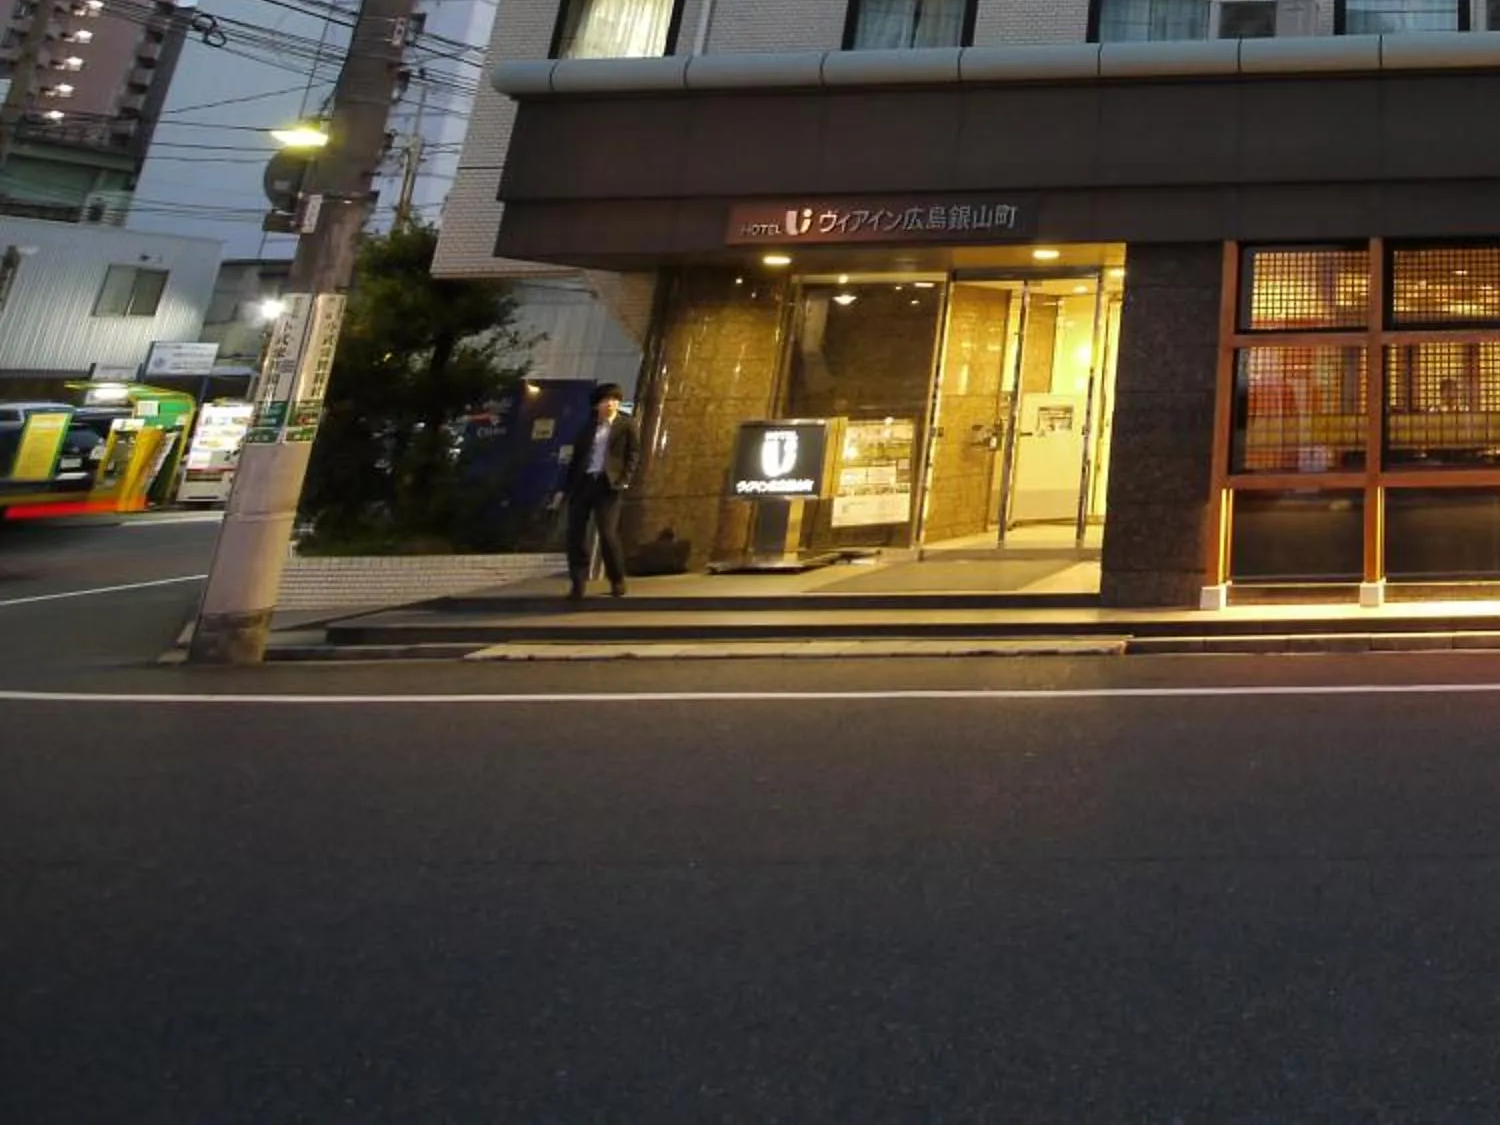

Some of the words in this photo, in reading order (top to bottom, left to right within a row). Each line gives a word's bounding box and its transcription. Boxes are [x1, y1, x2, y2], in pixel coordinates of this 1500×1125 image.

[741, 222, 781, 236] HOTEL
[819, 203, 1019, 234] ヴィアイン広島銀山町
